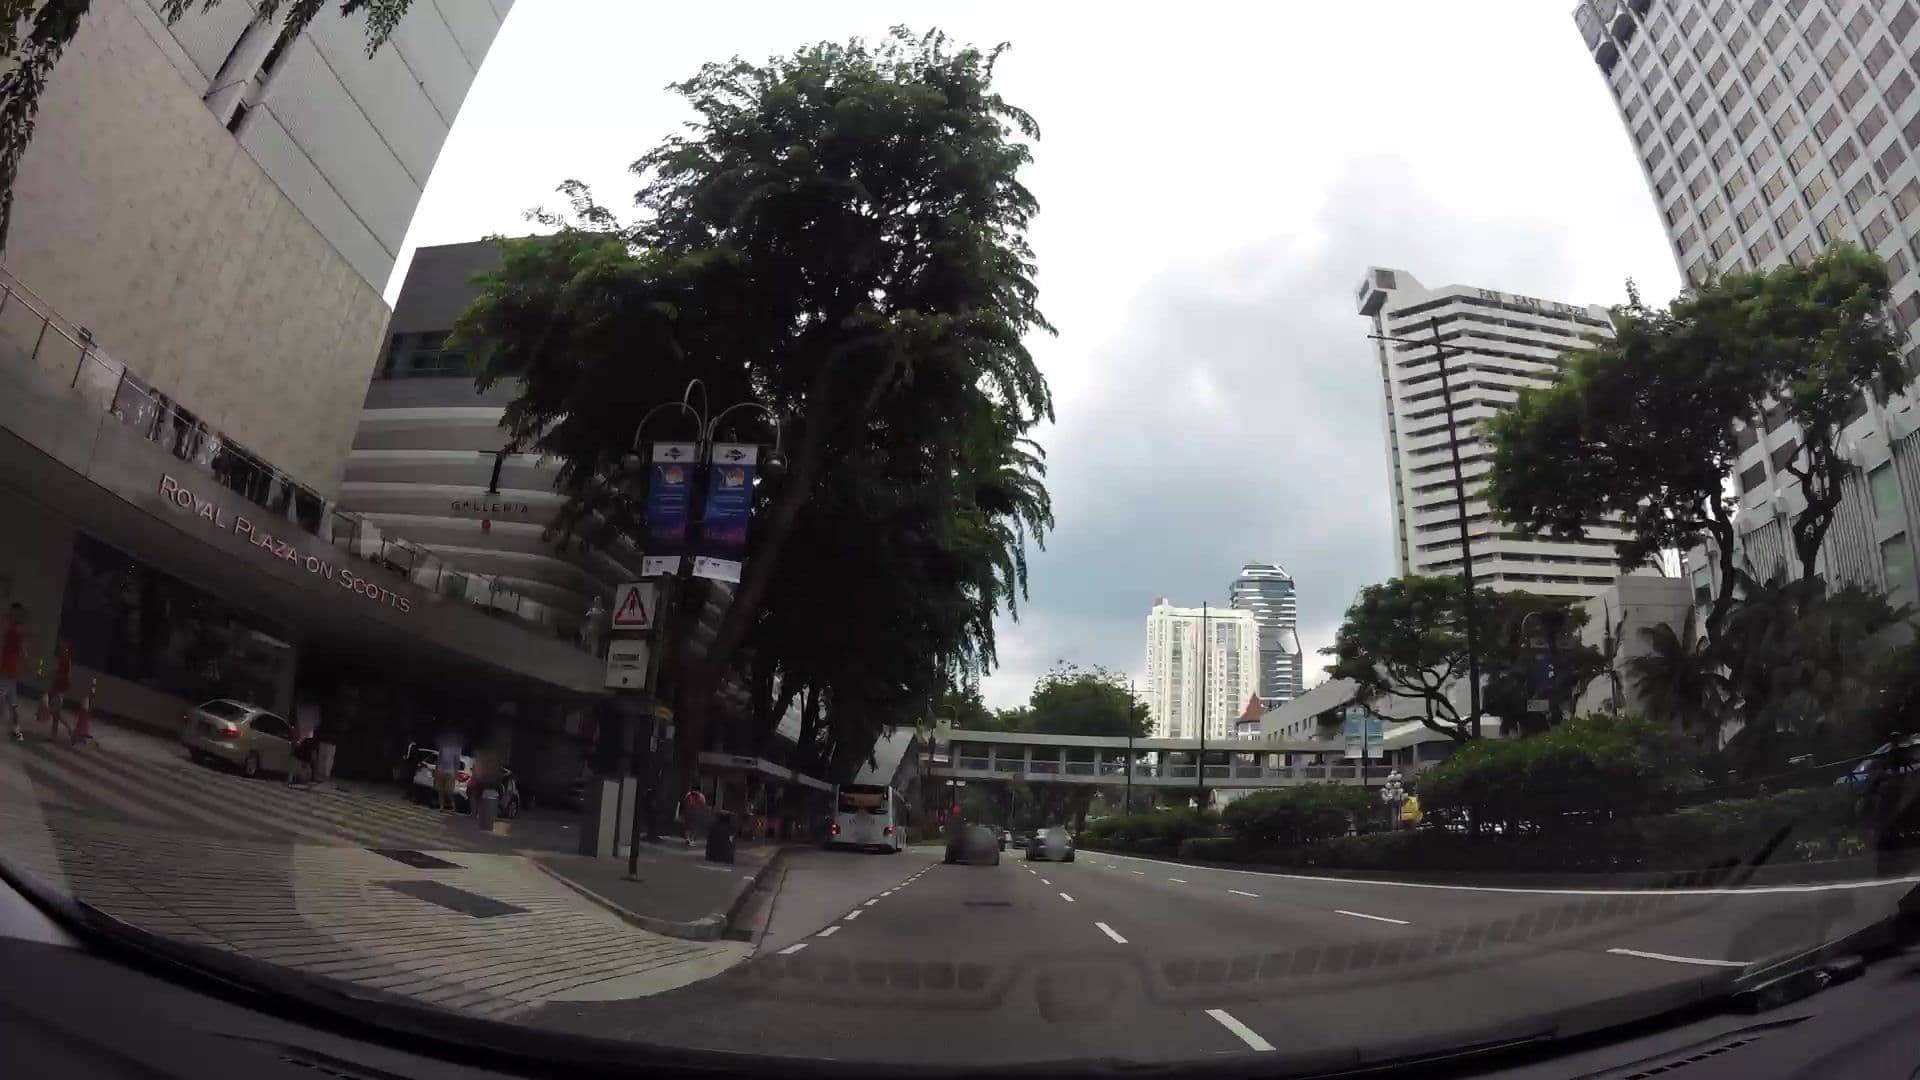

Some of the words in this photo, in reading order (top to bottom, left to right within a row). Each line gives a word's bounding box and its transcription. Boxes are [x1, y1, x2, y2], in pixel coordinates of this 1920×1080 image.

[159, 474, 226, 528] ROYAL
[233, 515, 298, 566] PLAZA
[305, 556, 333, 580] ON
[339, 569, 411, 613] SCOTTS
